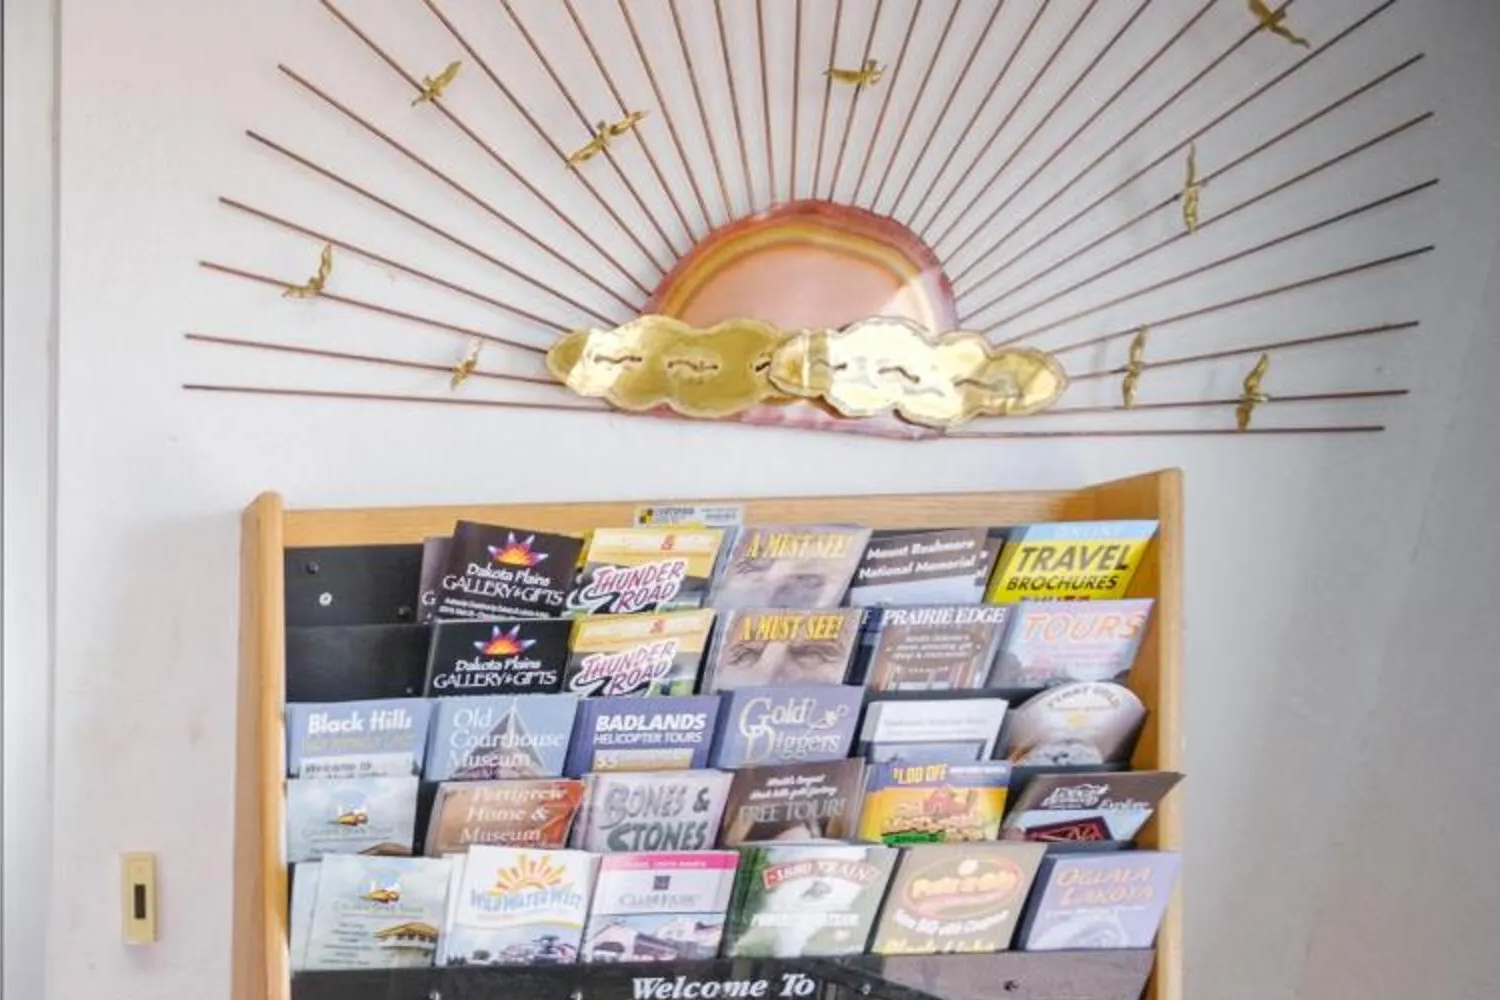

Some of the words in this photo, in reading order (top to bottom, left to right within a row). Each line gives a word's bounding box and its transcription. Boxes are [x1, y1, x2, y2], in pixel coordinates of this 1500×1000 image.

[859, 562, 914, 579] National
[915, 555, 976, 572] Memorial
[1017, 545, 1132, 572] TRAVEL
[467, 562, 514, 580] Dakota
[515, 568, 550, 586] Plains
[592, 561, 685, 592] THUNDER
[1006, 576, 1120, 591] BROCHURES
[615, 583, 676, 612] ROAD
[883, 608, 952, 626] PRAIRIE
[955, 607, 1008, 624] EDGE
[1025, 611, 1147, 641] TOURS
[455, 656, 502, 672] Dakota
[504, 655, 542, 669] Plains
[583, 640, 676, 677] THUNDER
[609, 661, 669, 696] ROAD
[308, 711, 365, 735] Black
[369, 708, 413, 731] Hills
[453, 707, 492, 728] Old
[595, 713, 707, 731] BADLANDS
[740, 697, 817, 737] Gold
[450, 729, 565, 749] Courthouse
[594, 732, 664, 745] HELICOPTER
[666, 731, 703, 743] TOURS
[746, 725, 840, 764] Diggers
[450, 751, 531, 767] Museum
[467, 807, 524, 823] Home
[531, 806, 549, 821] &
[601, 782, 688, 826] BONES
[693, 787, 710, 813] &
[739, 804, 780, 822] FREE
[460, 828, 541, 843] Museum
[607, 821, 708, 851] STONES
[632, 976, 770, 1000] Welcome
[780, 973, 815, 997] To
